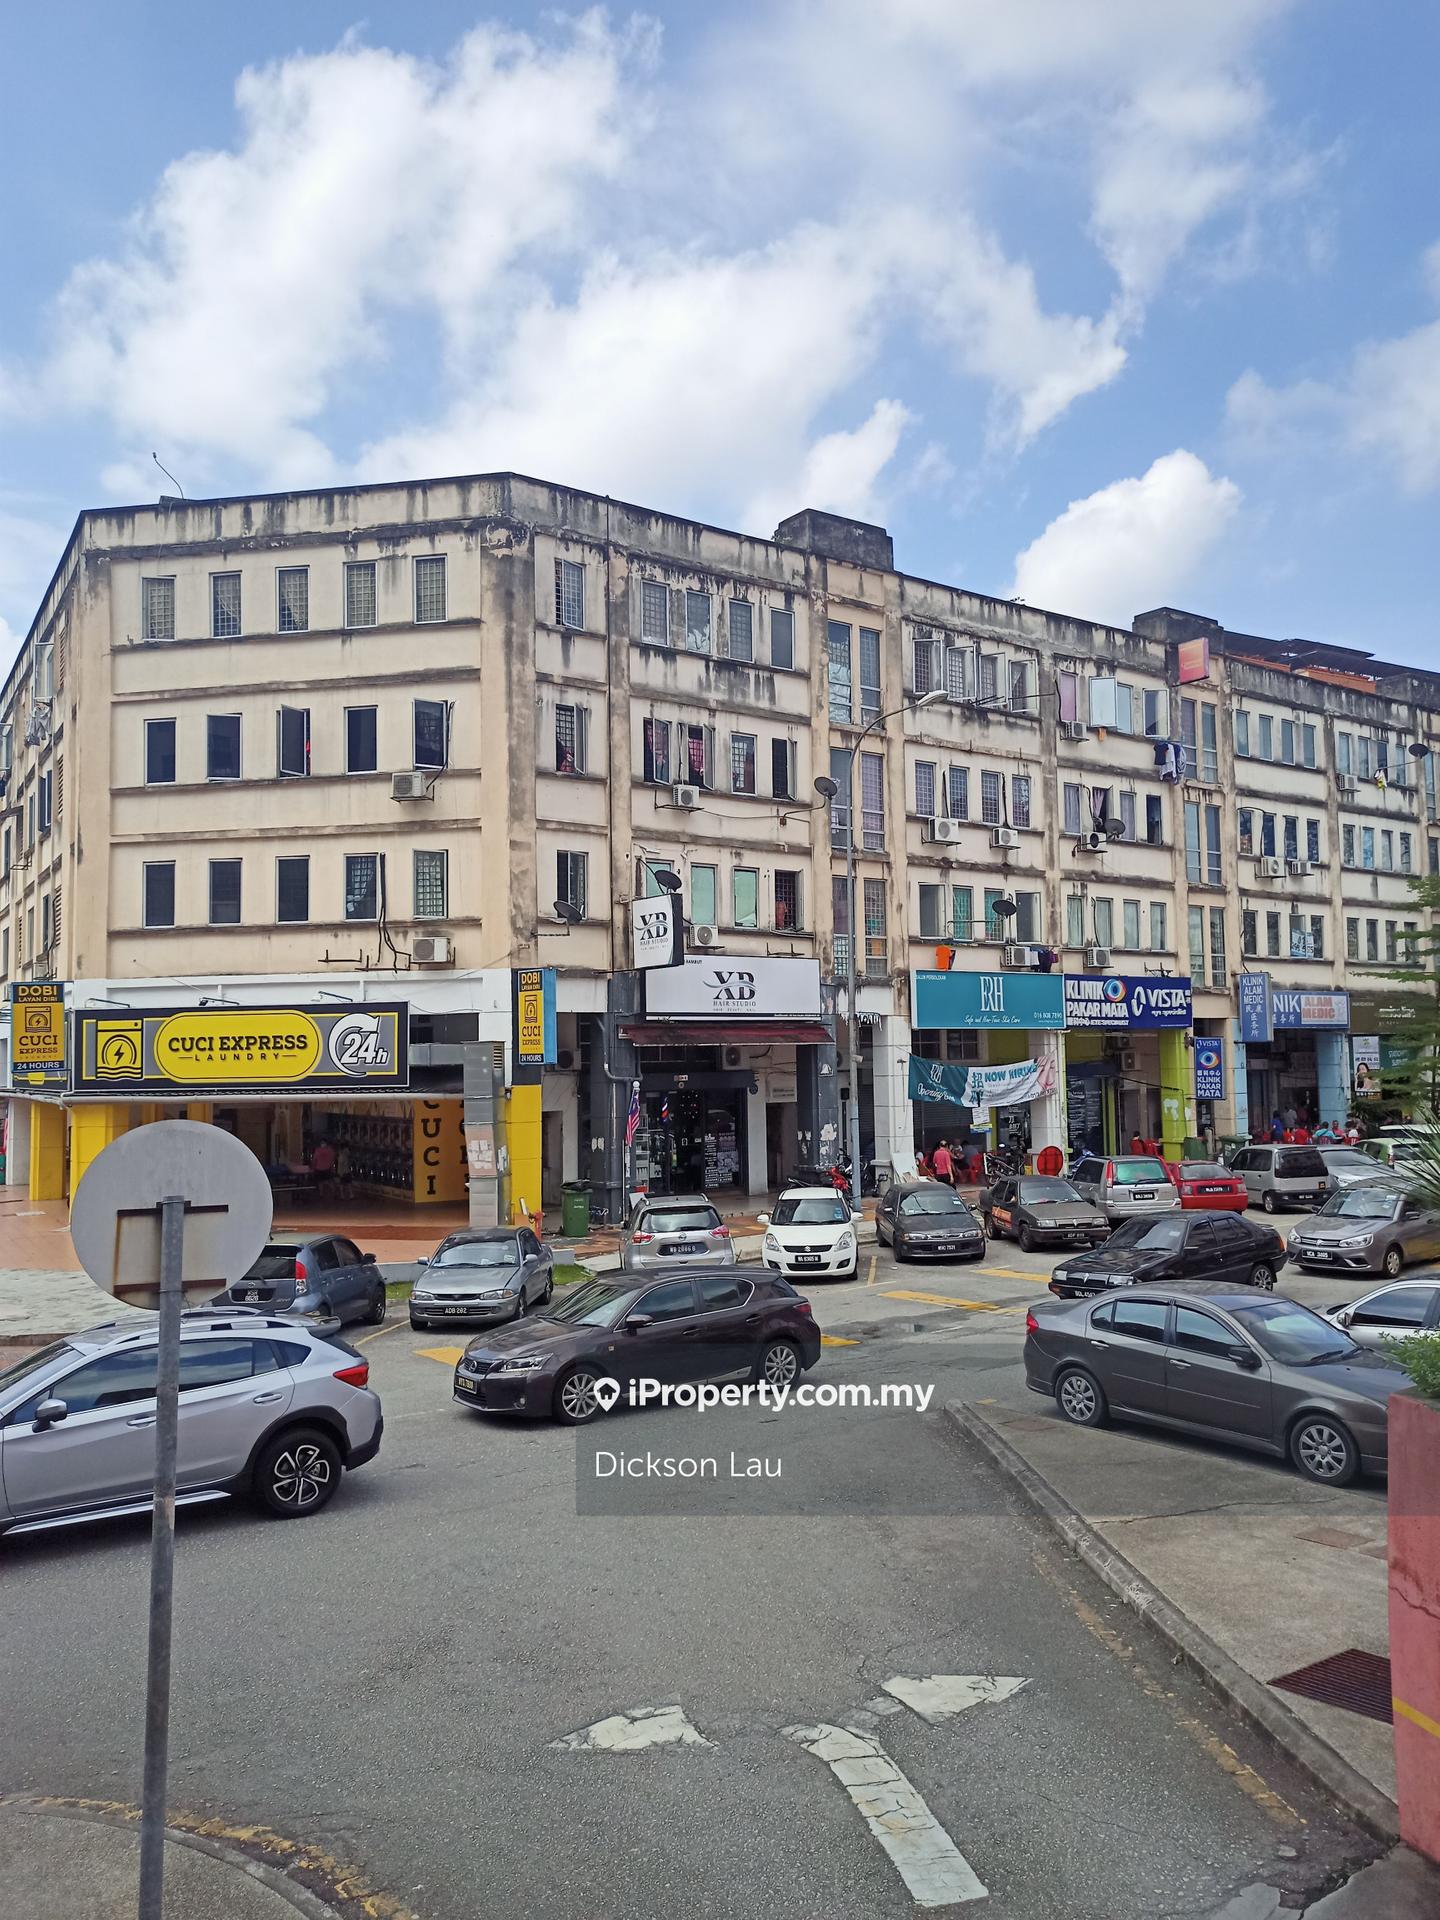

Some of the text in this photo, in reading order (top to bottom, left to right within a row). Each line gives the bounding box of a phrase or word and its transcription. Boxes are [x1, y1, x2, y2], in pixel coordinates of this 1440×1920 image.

[521, 971, 540, 985] DOBI
[1243, 976, 1264, 986] KLINIK
[18, 985, 57, 996] DOBI
[713, 971, 756, 1000] XB
[1066, 980, 1105, 1000] KLINIK
[1244, 986, 1262, 995] ALAM
[1147, 989, 1187, 1008] VISTA
[1243, 995, 1263, 1005] MEDIC
[1304, 997, 1333, 1008] ALAM
[1067, 1001, 1129, 1018] PAKAR MATA
[1302, 1007, 1335, 1019] MEDIC
[522, 1026, 541, 1037] CUCI
[19, 1035, 58, 1046] CUCI
[168, 1034, 308, 1052] CUCI EXPRESS
[339, 1031, 389, 1065] 24h
[194, 1052, 280, 1062] LAUNDRY
[521, 1054, 542, 1062] 24 HOURS
[17, 1061, 60, 1070] 24 HOURS
[985, 1070, 1006, 1082] NOW
